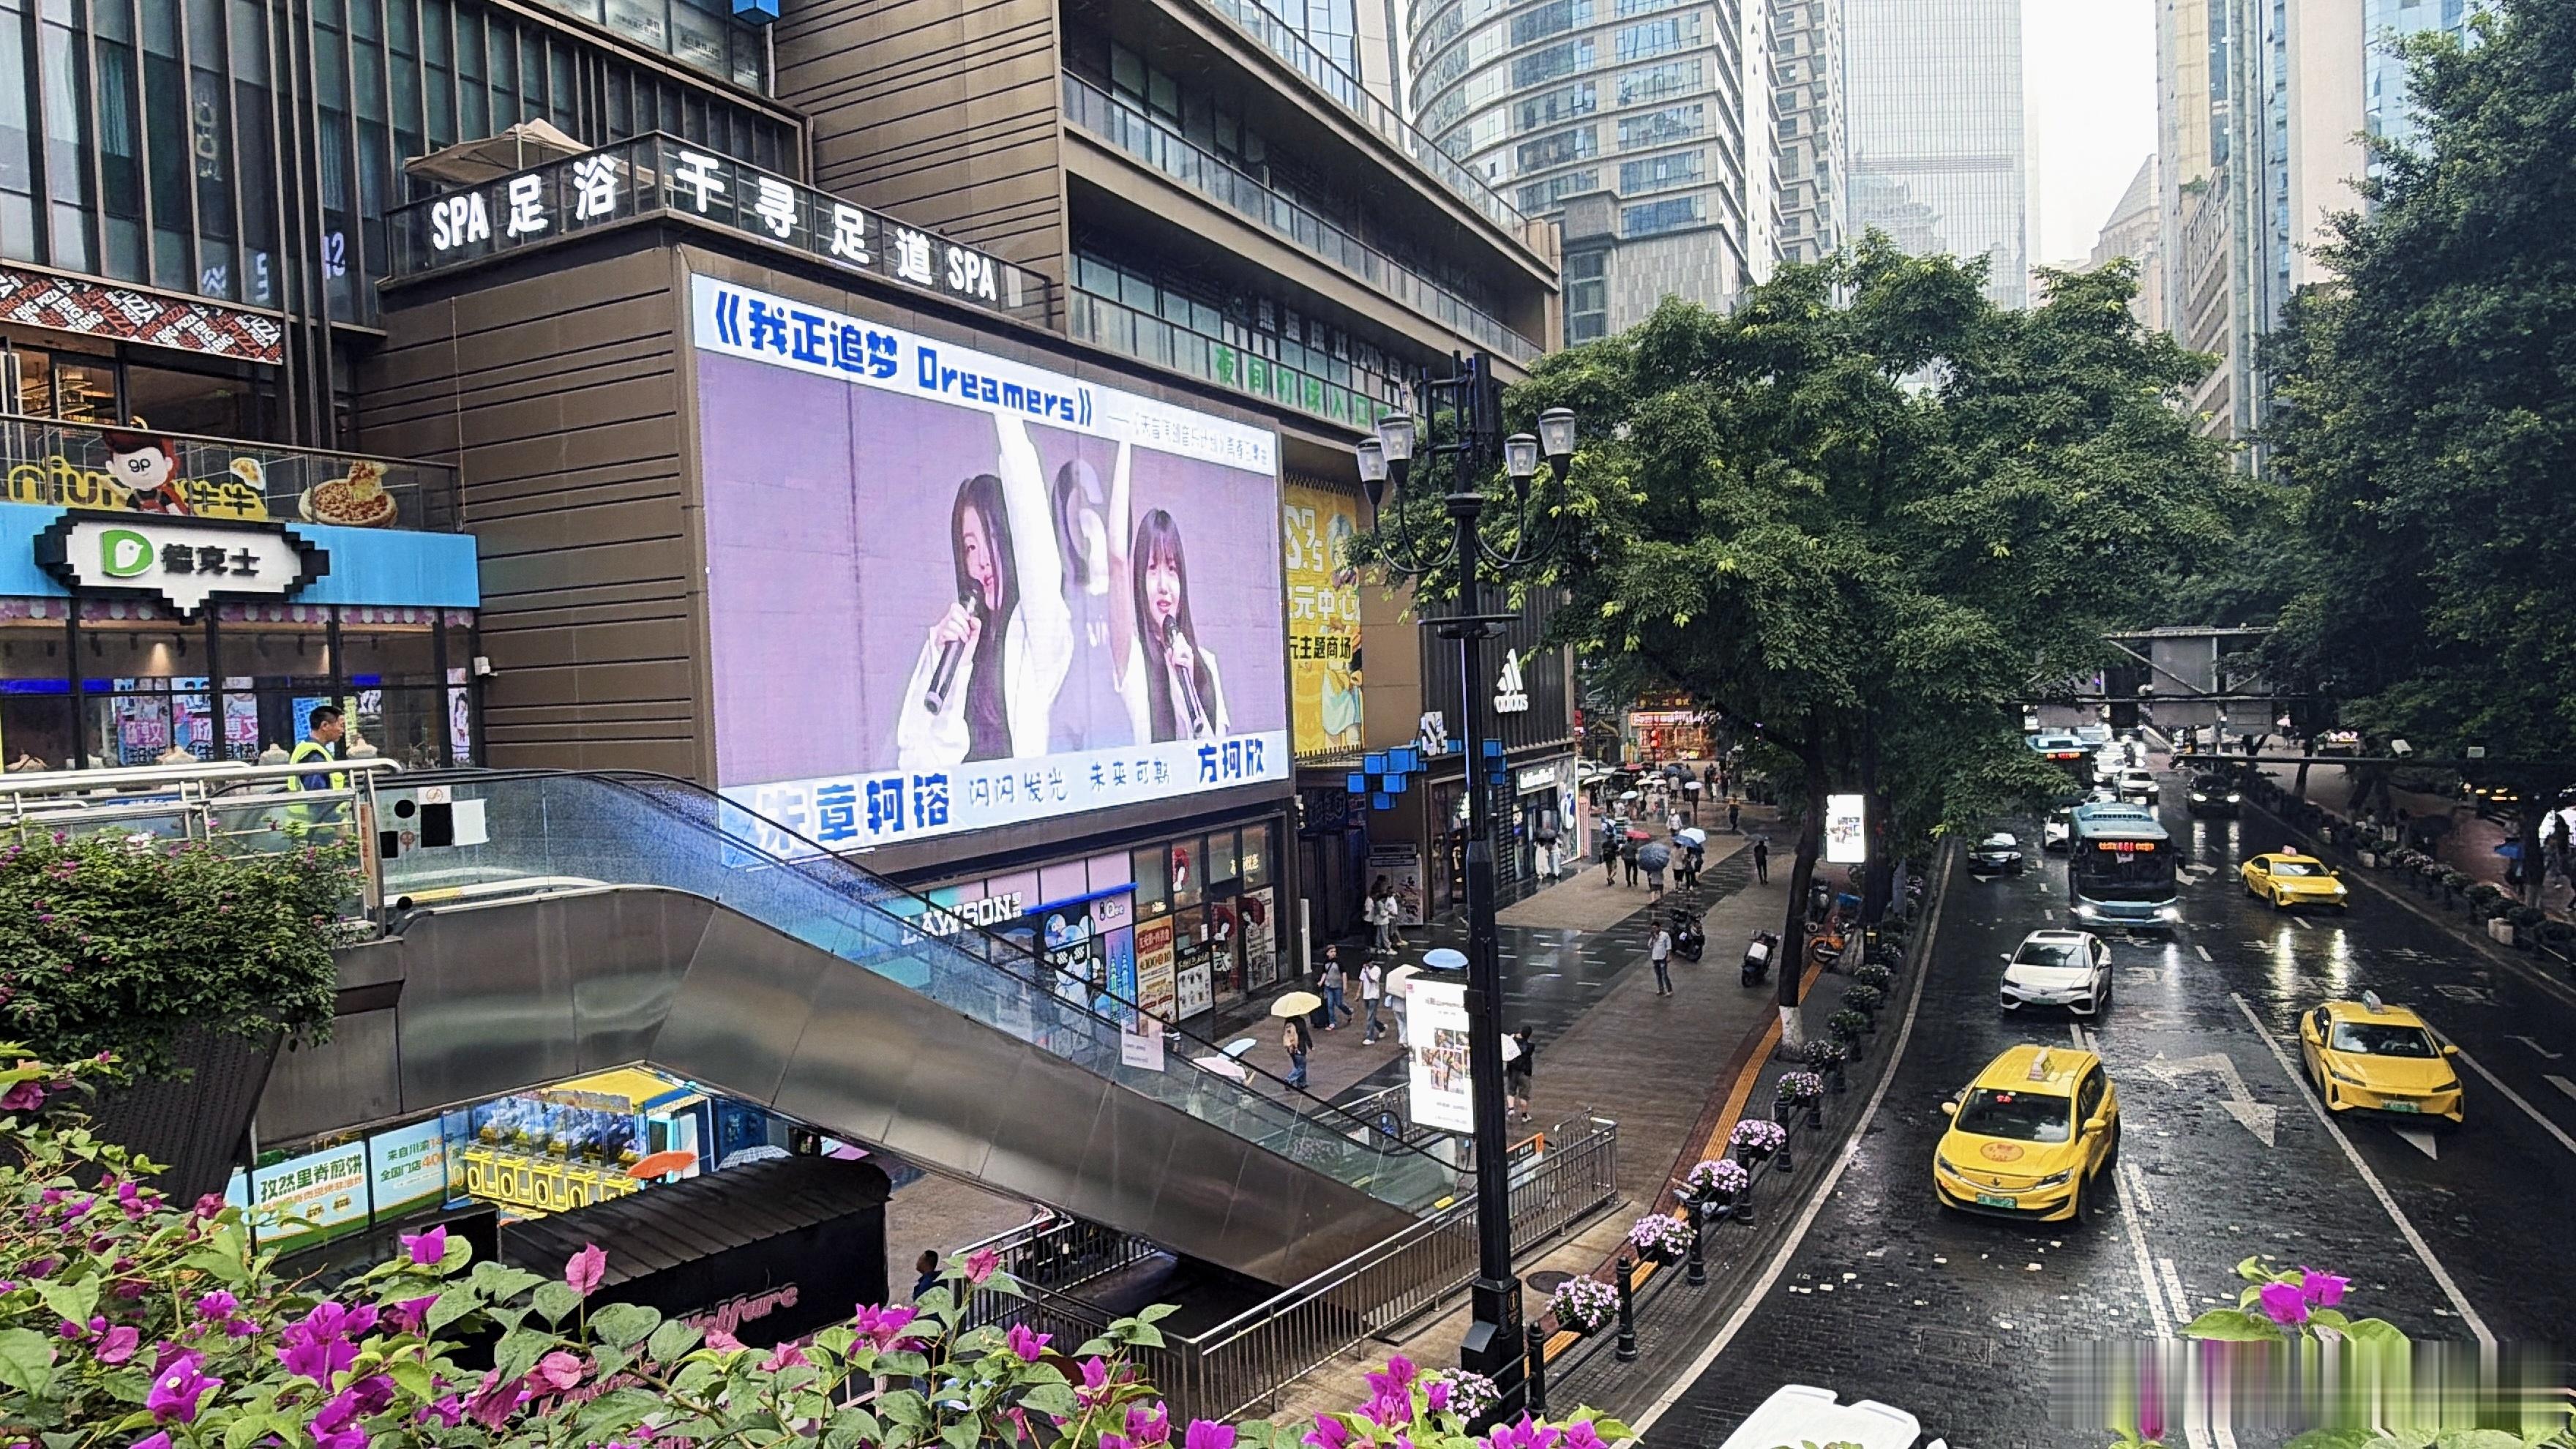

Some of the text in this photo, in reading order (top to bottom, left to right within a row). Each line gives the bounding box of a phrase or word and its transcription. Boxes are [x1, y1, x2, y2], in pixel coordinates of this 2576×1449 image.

[13, 301, 40, 321] BIG
[78, 310, 104, 329] BIG
[156, 325, 179, 343] BIG
[212, 333, 235, 352] BIG
[716, 290, 898, 379] 《我正追梦
[969, 767, 1068, 806] 闪闪发光
[1090, 757, 1170, 792] 未来可期
[1198, 738, 1265, 785] 方珂欣
[261, 1153, 362, 1203] 孜然里脊煎饼
